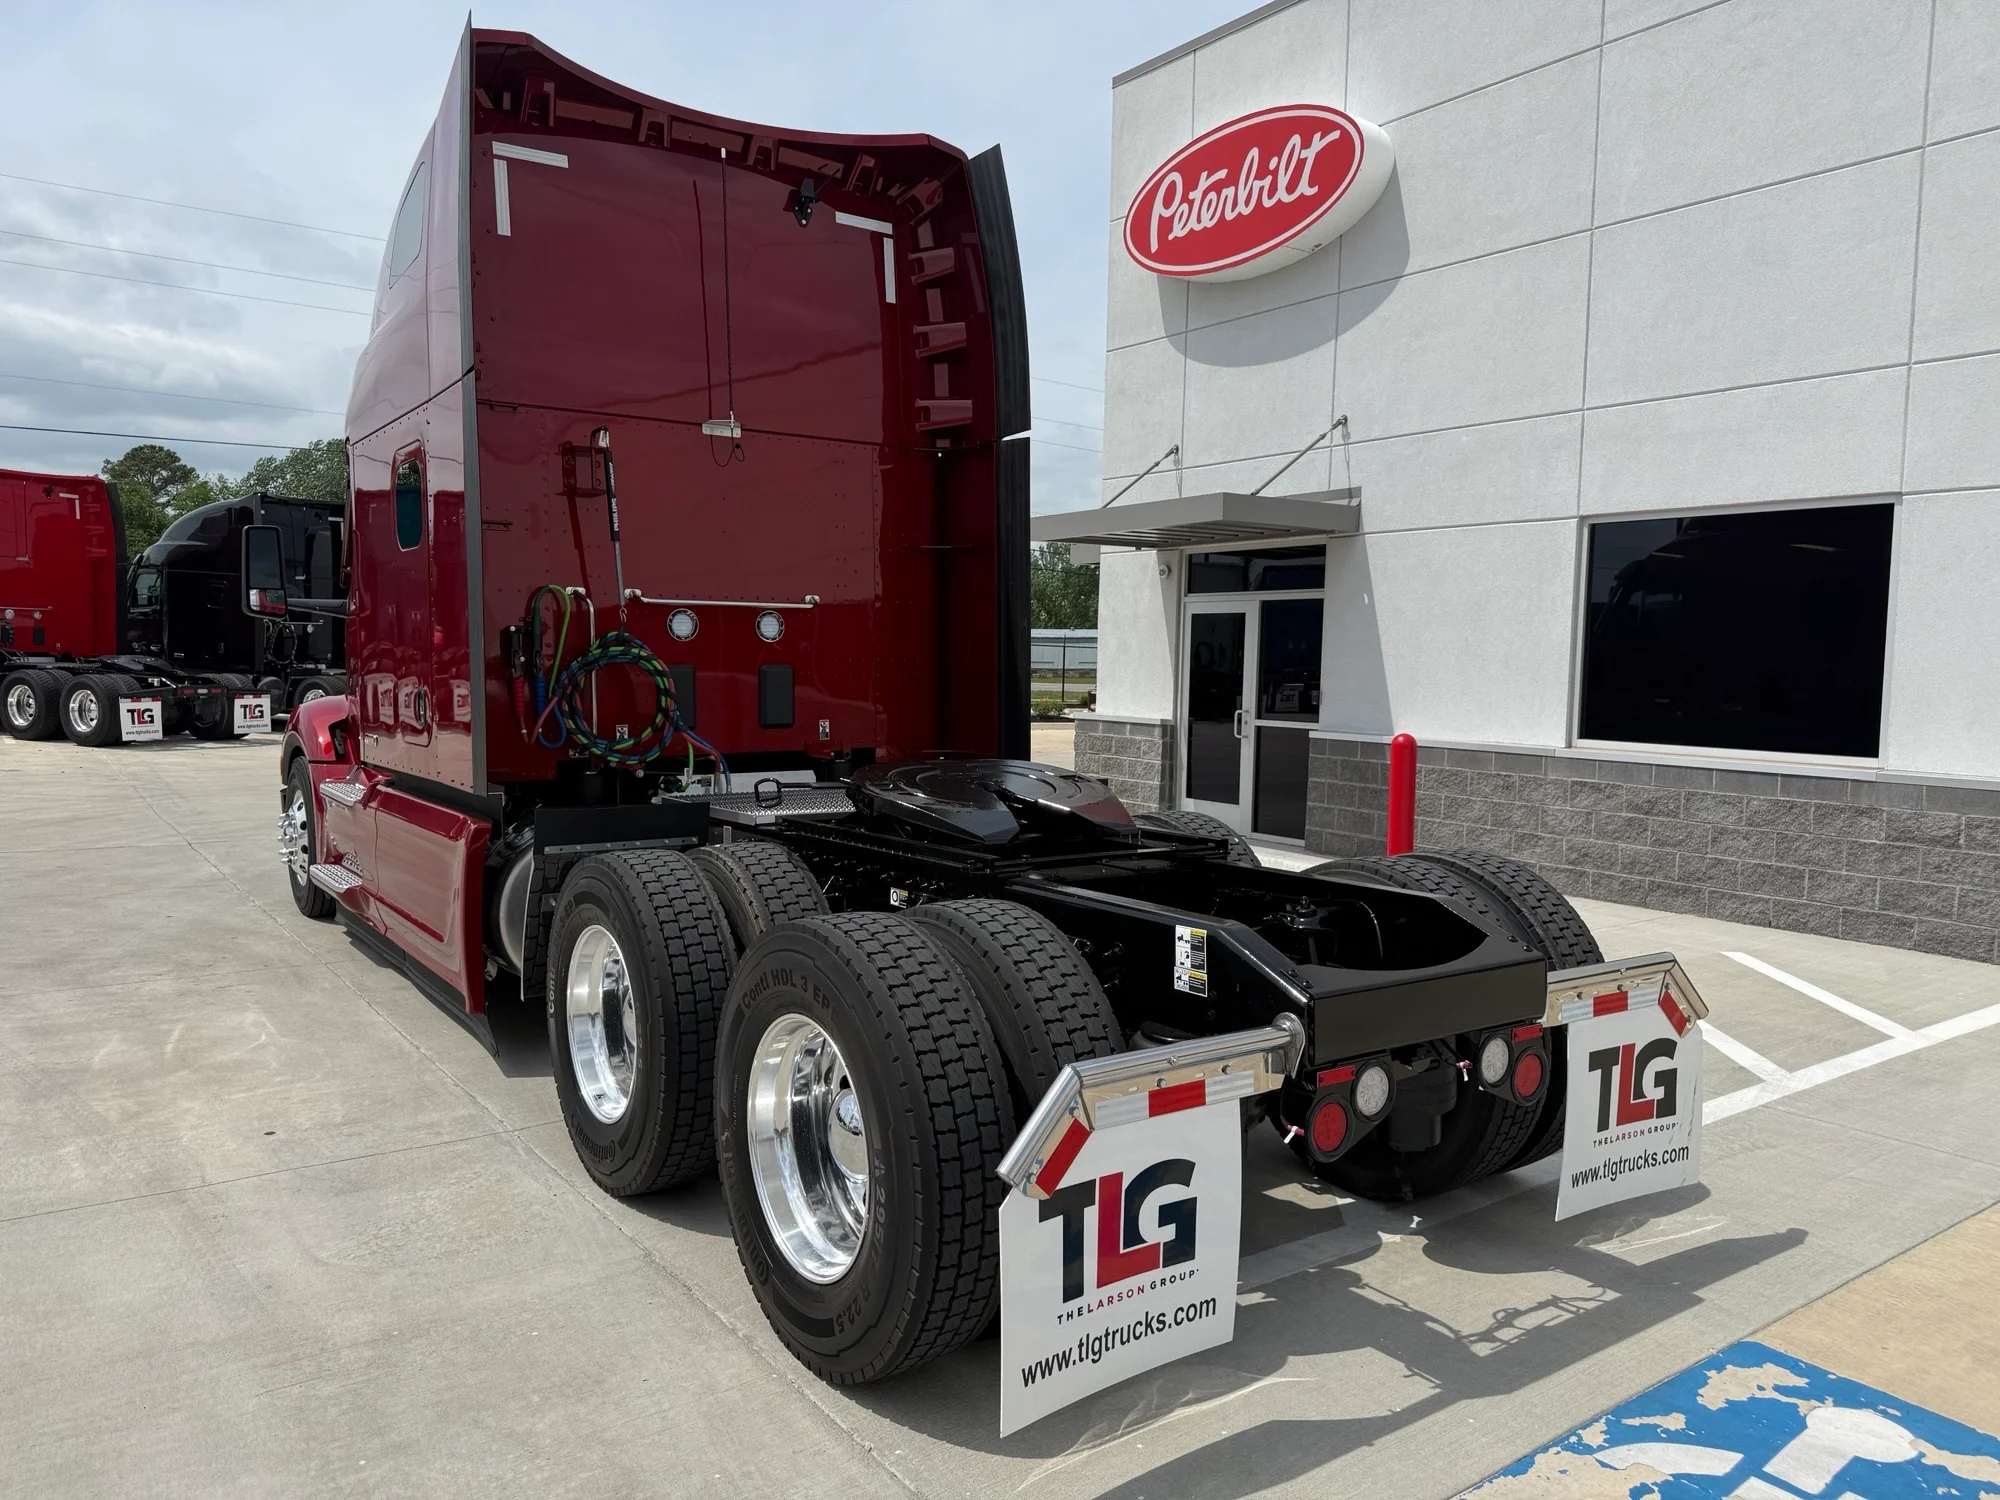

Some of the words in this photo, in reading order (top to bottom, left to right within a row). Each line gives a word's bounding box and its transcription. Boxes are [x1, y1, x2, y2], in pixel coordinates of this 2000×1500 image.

[1150, 129, 1341, 253] Peterbilt
[127, 708, 154, 725] TLG
[240, 704, 264, 719] TLG
[742, 971, 770, 1009] Conti
[770, 967, 798, 989] HDL
[800, 974, 809, 993] 3
[813, 983, 831, 1010] EP
[1589, 1038, 1678, 1133] TLG
[1647, 1122, 1677, 1134] GROUP
[1571, 1145, 1690, 1188] www.tlgtrucks.com
[1038, 1158, 1198, 1304] TLG
[1149, 1269, 1198, 1290] GROUP
[1022, 1297, 1217, 1388] www.tlgtrucks.com
